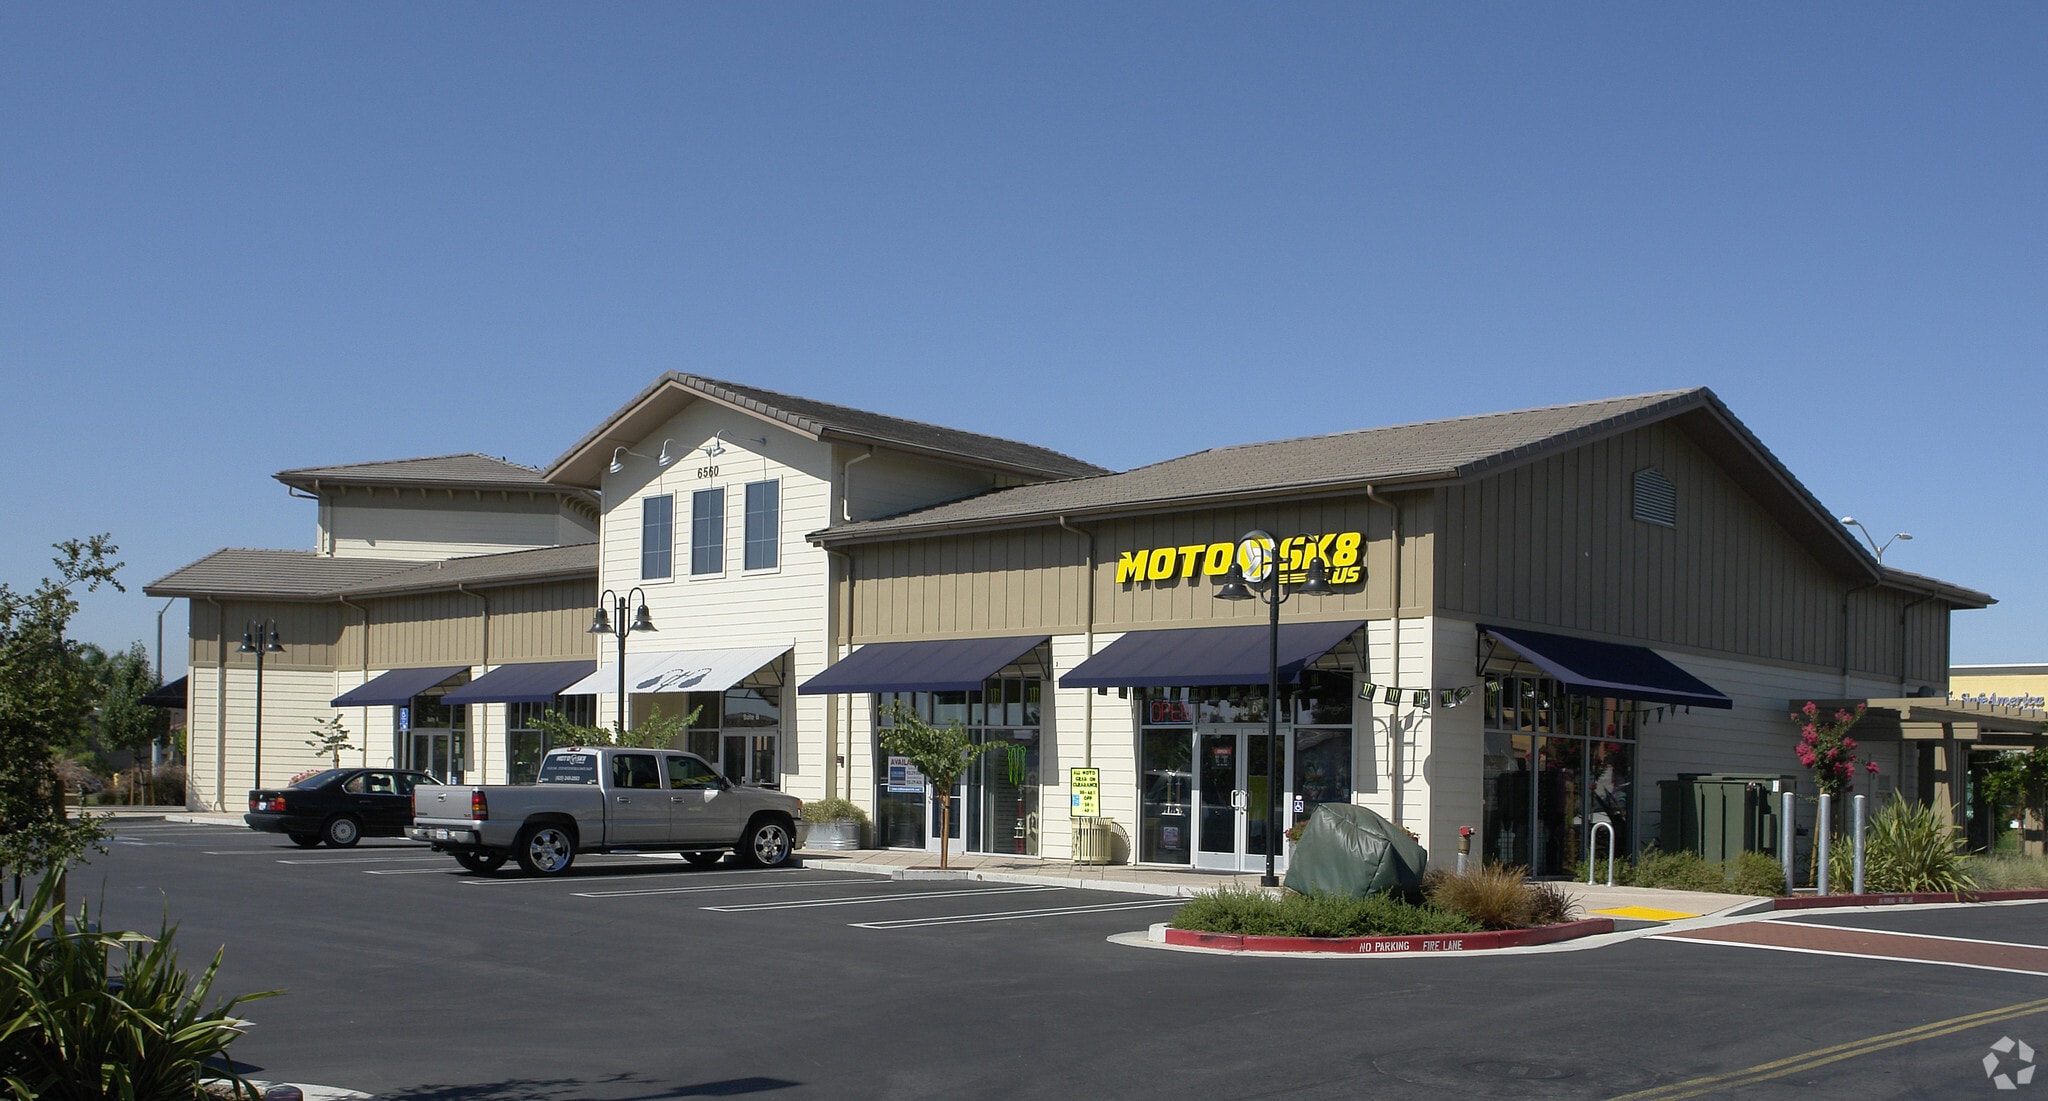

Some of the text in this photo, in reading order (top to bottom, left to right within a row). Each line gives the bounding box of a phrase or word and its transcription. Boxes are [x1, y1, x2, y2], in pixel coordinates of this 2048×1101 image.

[698, 465, 719, 479] 6560
[1116, 532, 1361, 584] MOTO SK8
[1151, 702, 1192, 722] OPEN
[1231, 705, 1258, 714] Suite D
[1359, 940, 1463, 952] NO PARKING FIRE LANE
